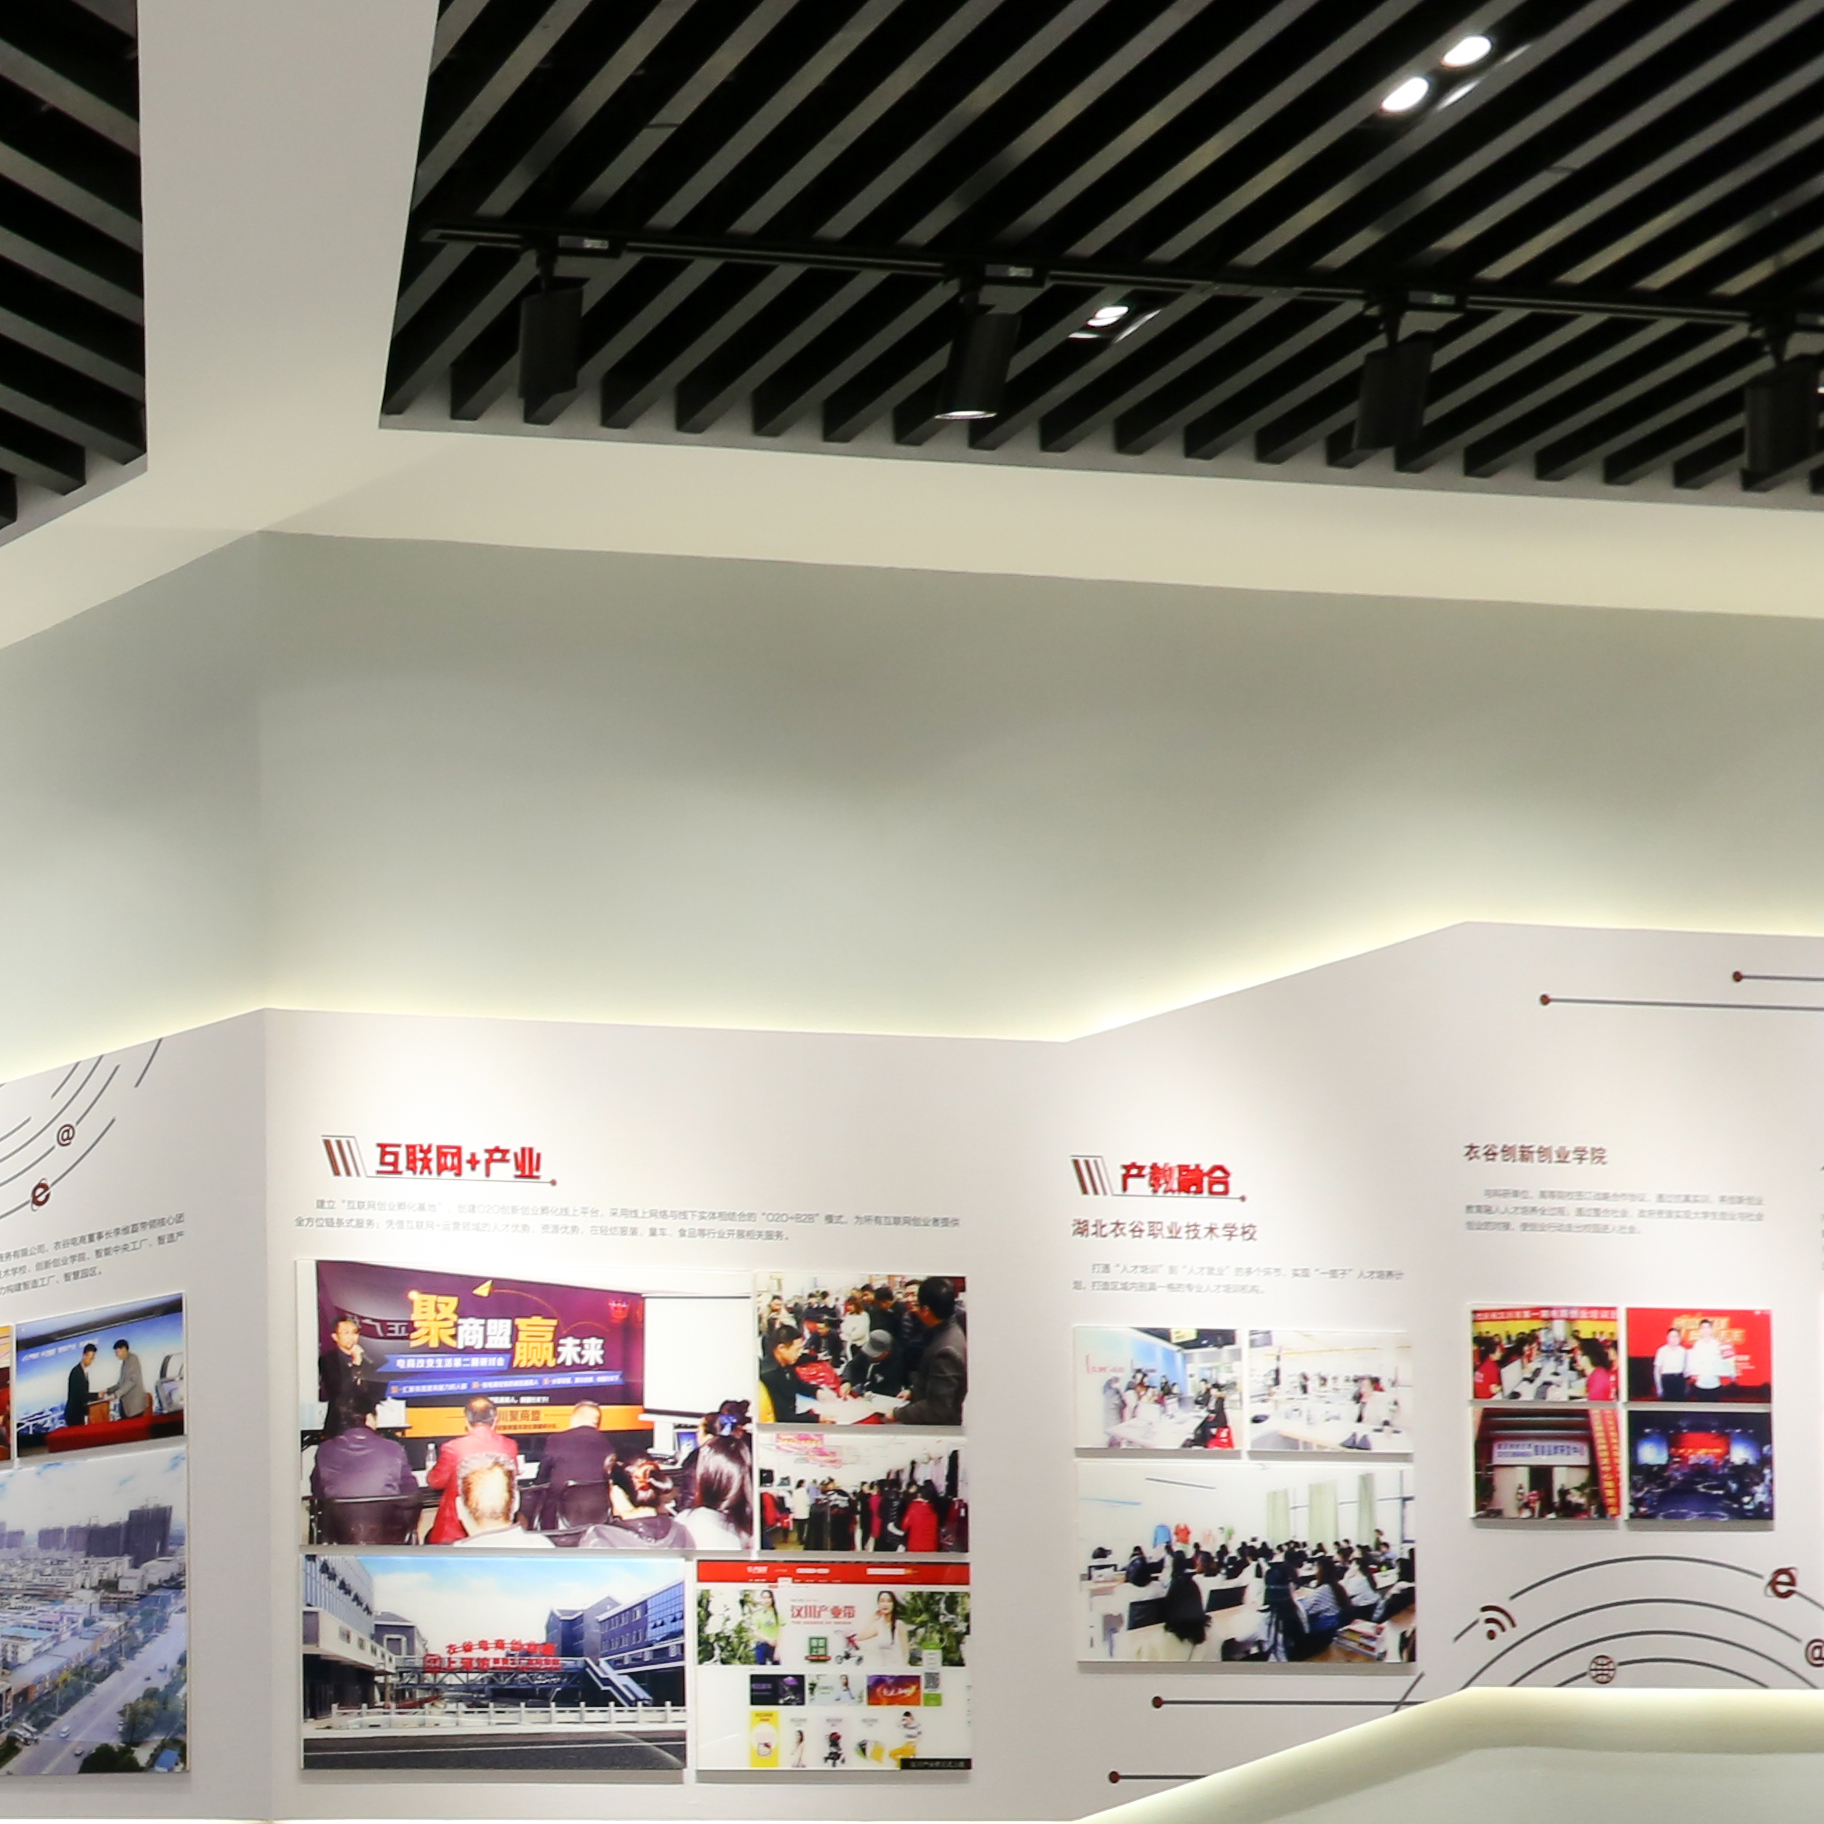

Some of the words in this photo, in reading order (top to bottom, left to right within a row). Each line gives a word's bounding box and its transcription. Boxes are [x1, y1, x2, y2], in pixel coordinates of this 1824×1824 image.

[376, 1142, 541, 1181] 互联网+产业
[1121, 1162, 1231, 1196] 产教融合
[1070, 1218, 1259, 1242] 湖北衣谷职业技术学校
